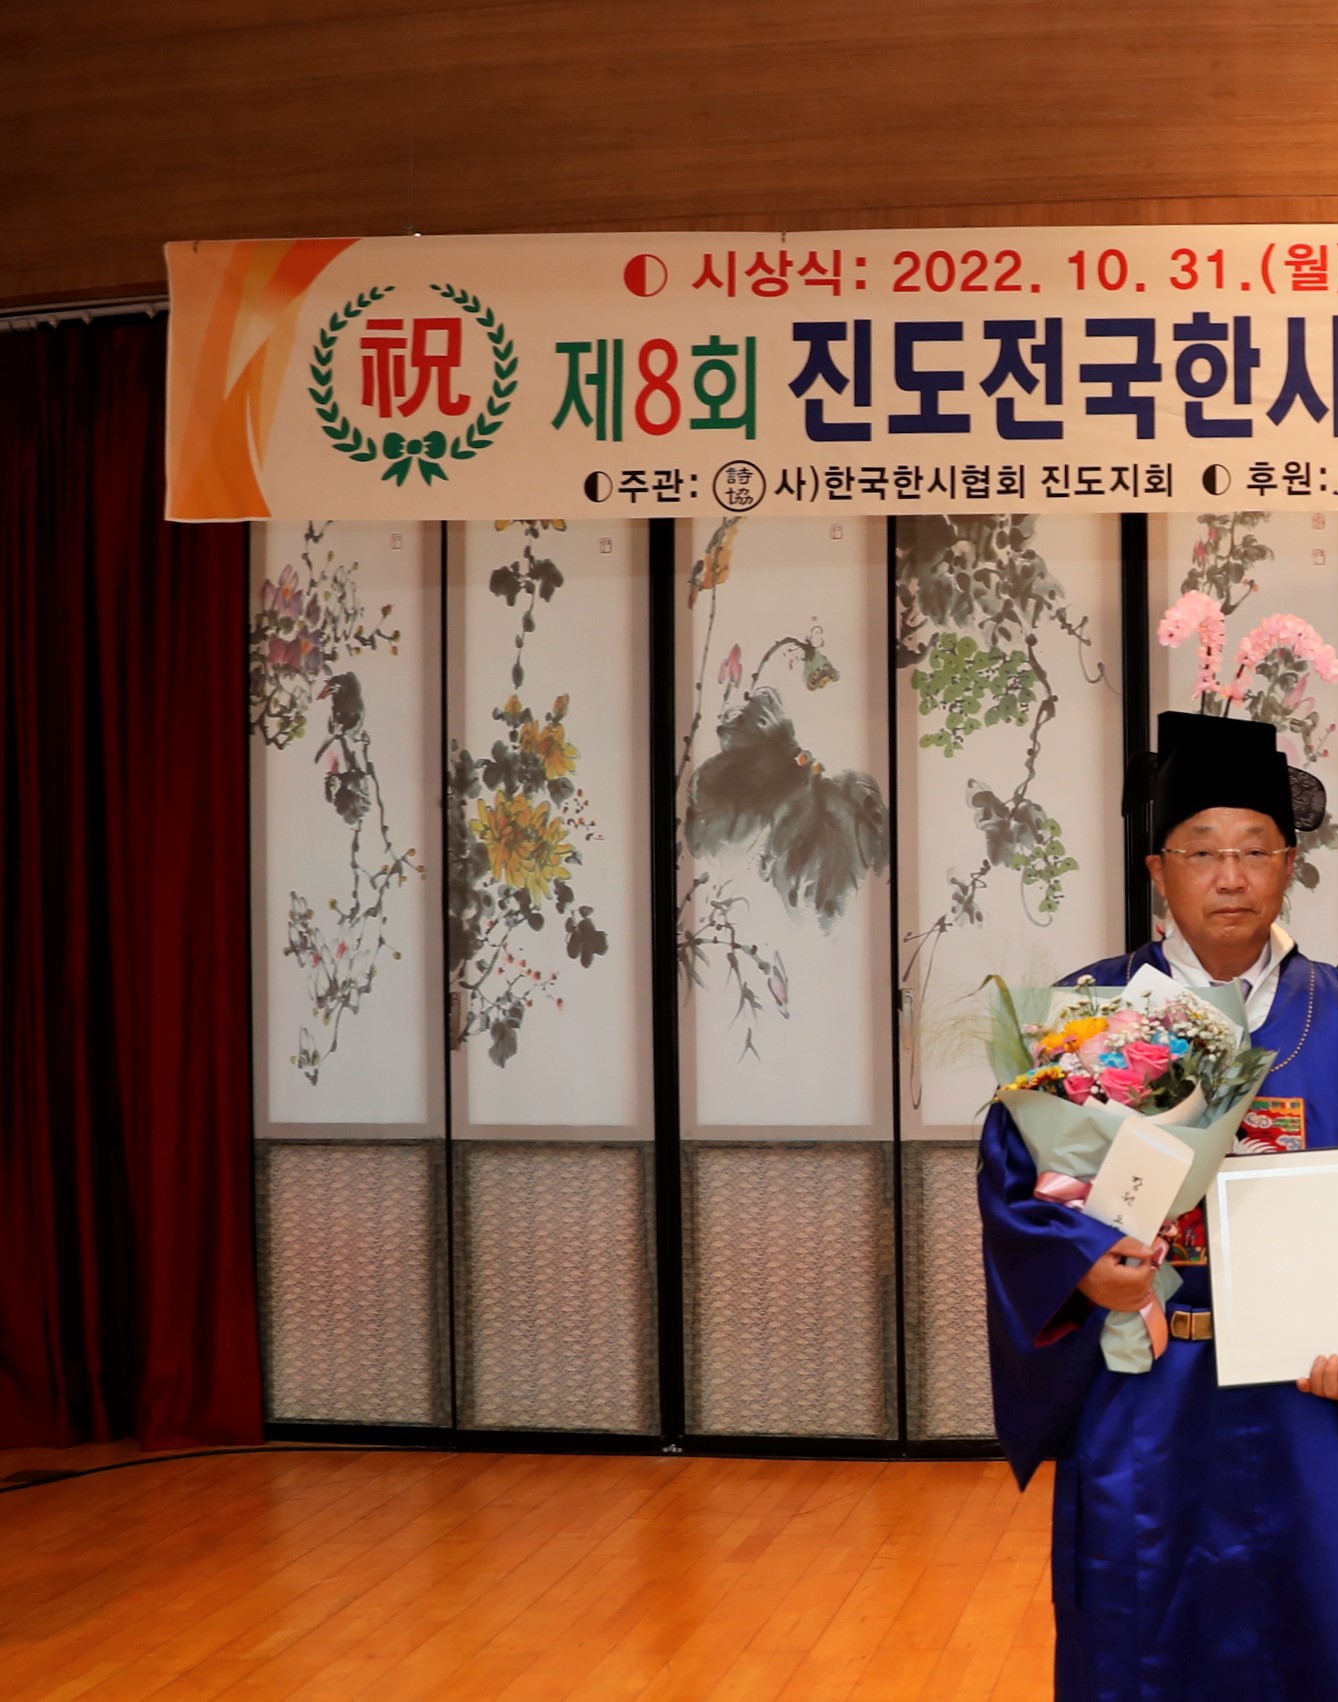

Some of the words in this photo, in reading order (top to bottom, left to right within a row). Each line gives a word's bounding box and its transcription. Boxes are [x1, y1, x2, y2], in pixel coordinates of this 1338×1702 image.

[692, 250, 866, 297] 시상식:
[893, 250, 1040, 294] 2022.
[1068, 249, 1146, 293] 10.
[359, 316, 472, 418] 祝
[551, 334, 757, 442] 제8회
[618, 469, 698, 503] 주관:
[774, 465, 1025, 502] 사)한국한시협회
[1041, 463, 1173, 498] 진도지회
[1247, 461, 1327, 496] 후원:
